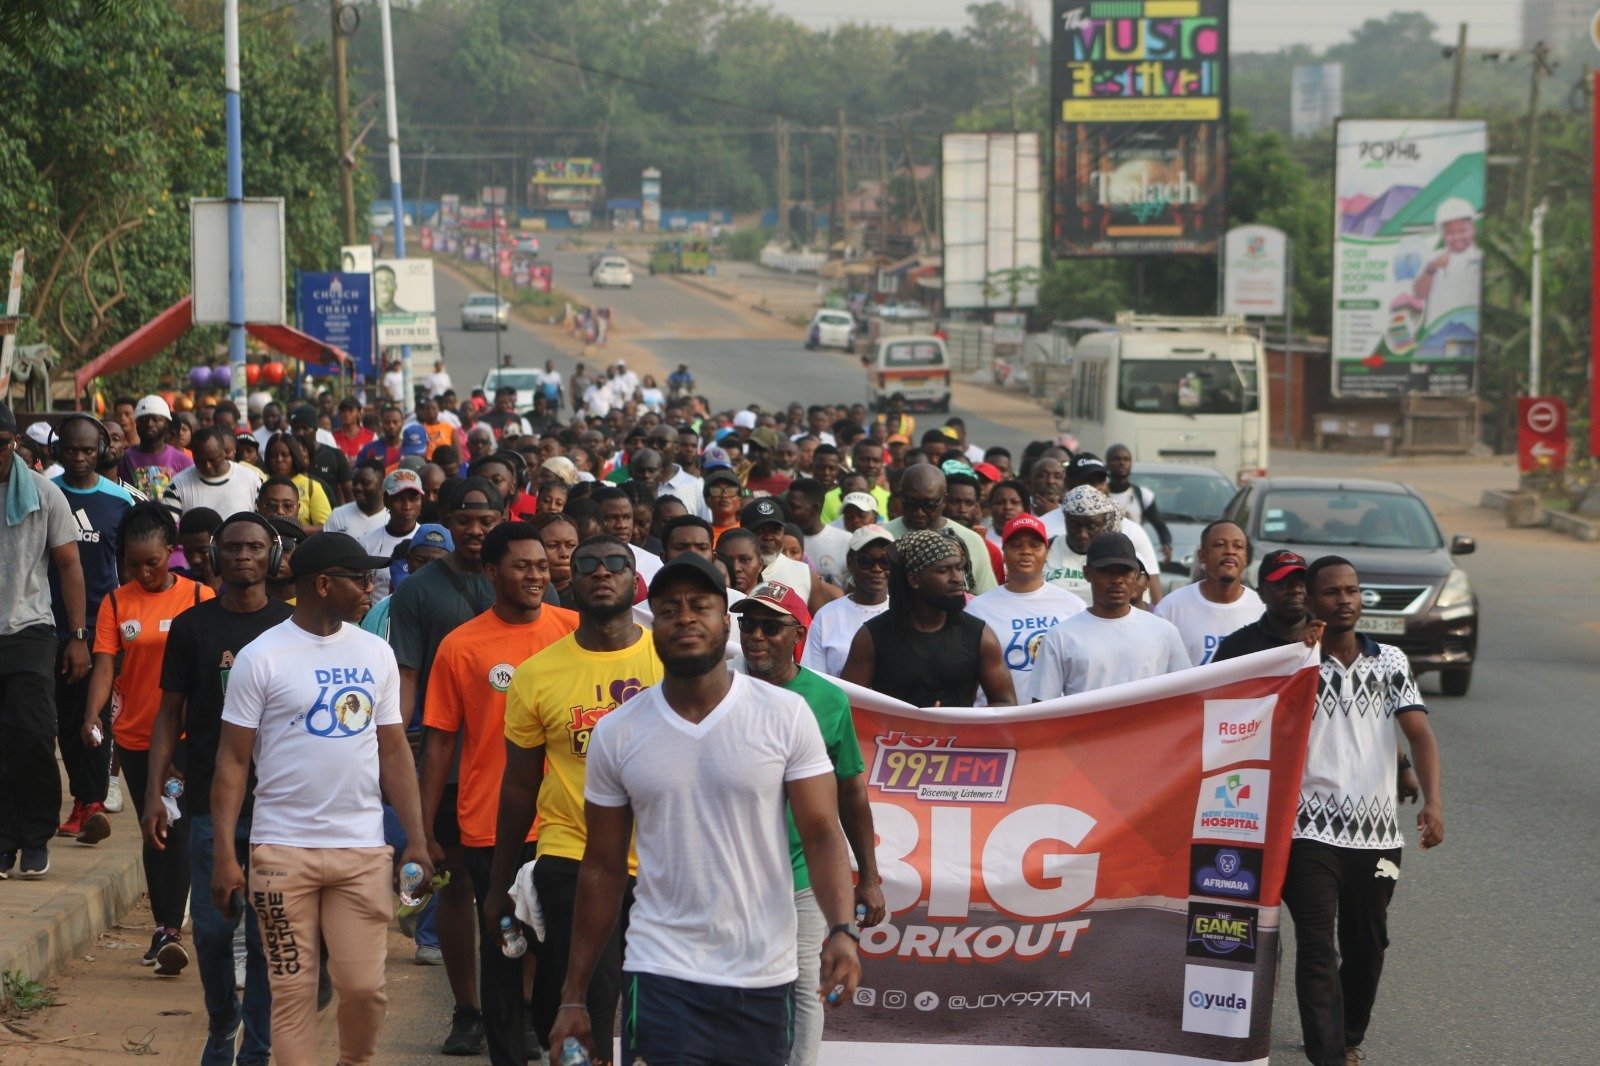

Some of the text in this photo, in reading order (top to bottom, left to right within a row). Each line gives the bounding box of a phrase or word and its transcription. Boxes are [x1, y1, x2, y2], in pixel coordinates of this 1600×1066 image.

[1072, 17, 1219, 61] MUSIC
[313, 290, 359, 300] CHURCH
[317, 305, 359, 315] CHRIST
[1012, 519, 1039, 528] DISCIPLE
[1011, 617, 1059, 630] DEKA
[315, 668, 375, 684] DEKA
[1218, 719, 1261, 736] Reedy
[951, 756, 999, 784] FM
[920, 787, 959, 800] Discerning
[960, 788, 993, 799] Listeners
[1201, 810, 1260, 820] NEW CRYSTAL
[1200, 818, 1259, 831] HOSPITAL
[850, 801, 1100, 917] BIG
[1202, 878, 1249, 891] AFRIWARA
[268, 892, 301, 975] CULTURE
[1195, 917, 1248, 939] GAME
[857, 915, 1092, 962] ORKOUT
[948, 990, 1090, 1010] @JOY997FM
